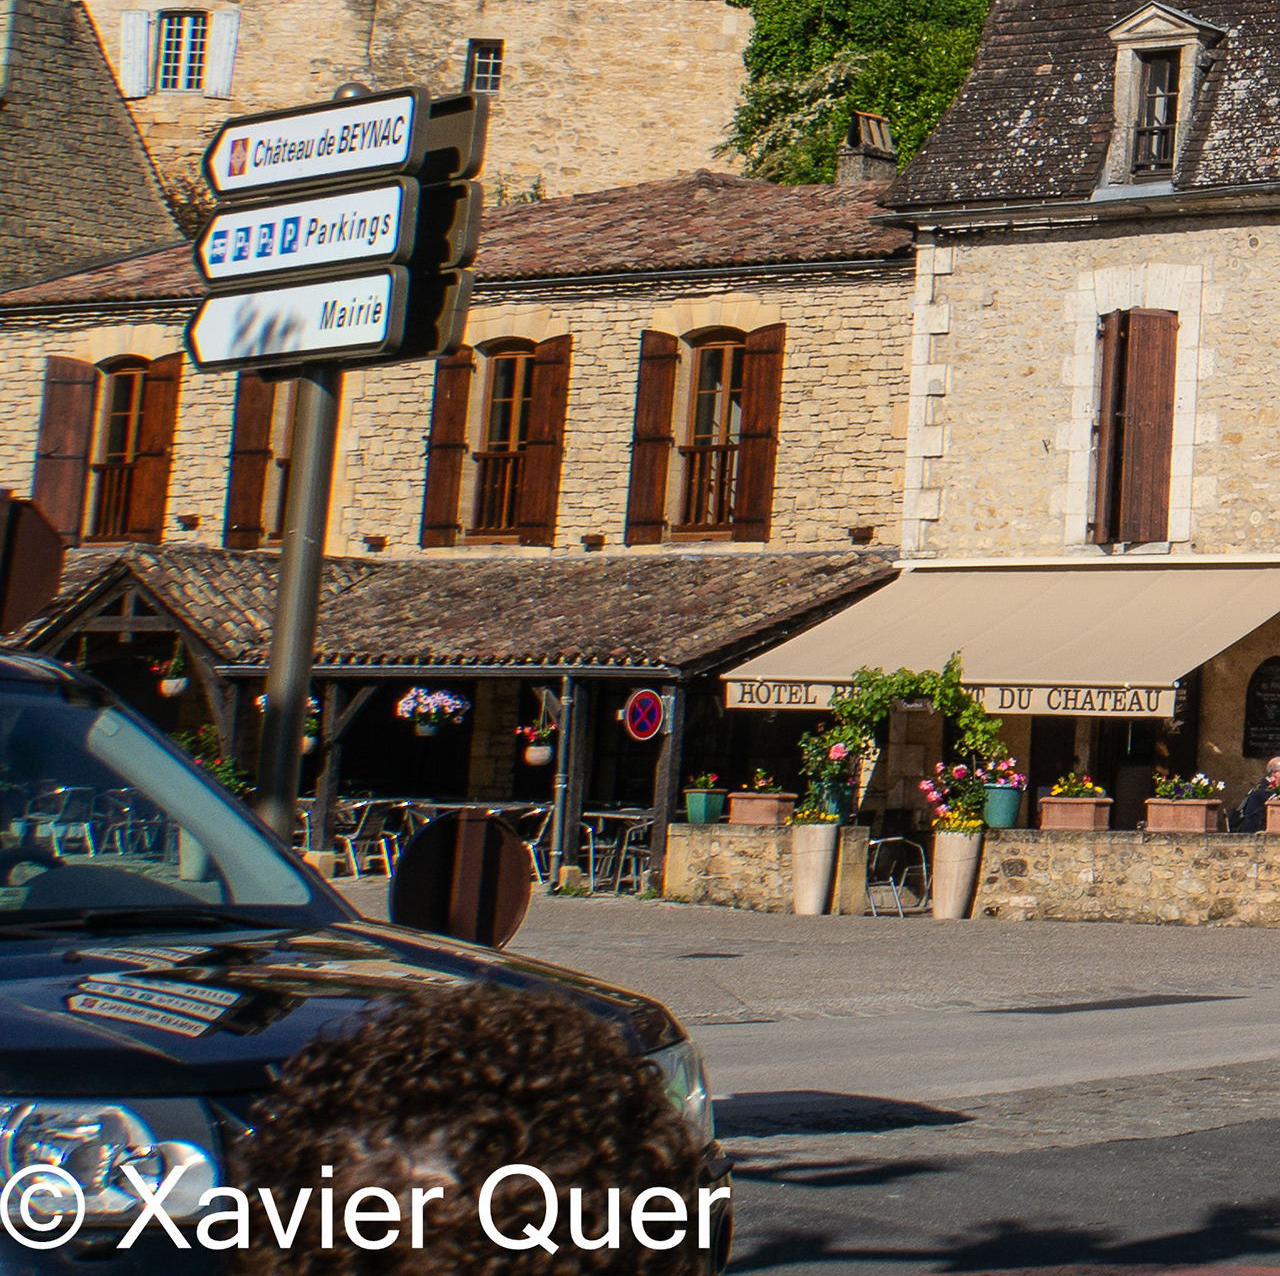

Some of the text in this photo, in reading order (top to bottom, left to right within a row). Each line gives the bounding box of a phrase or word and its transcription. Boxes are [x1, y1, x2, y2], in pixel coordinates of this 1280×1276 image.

[253, 116, 405, 168] Château de BEYNAC
[305, 211, 392, 247] Parkings
[319, 295, 383, 330] Mairie
[999, 688, 1033, 710] DU
[1047, 688, 1161, 712] CHATEAU
